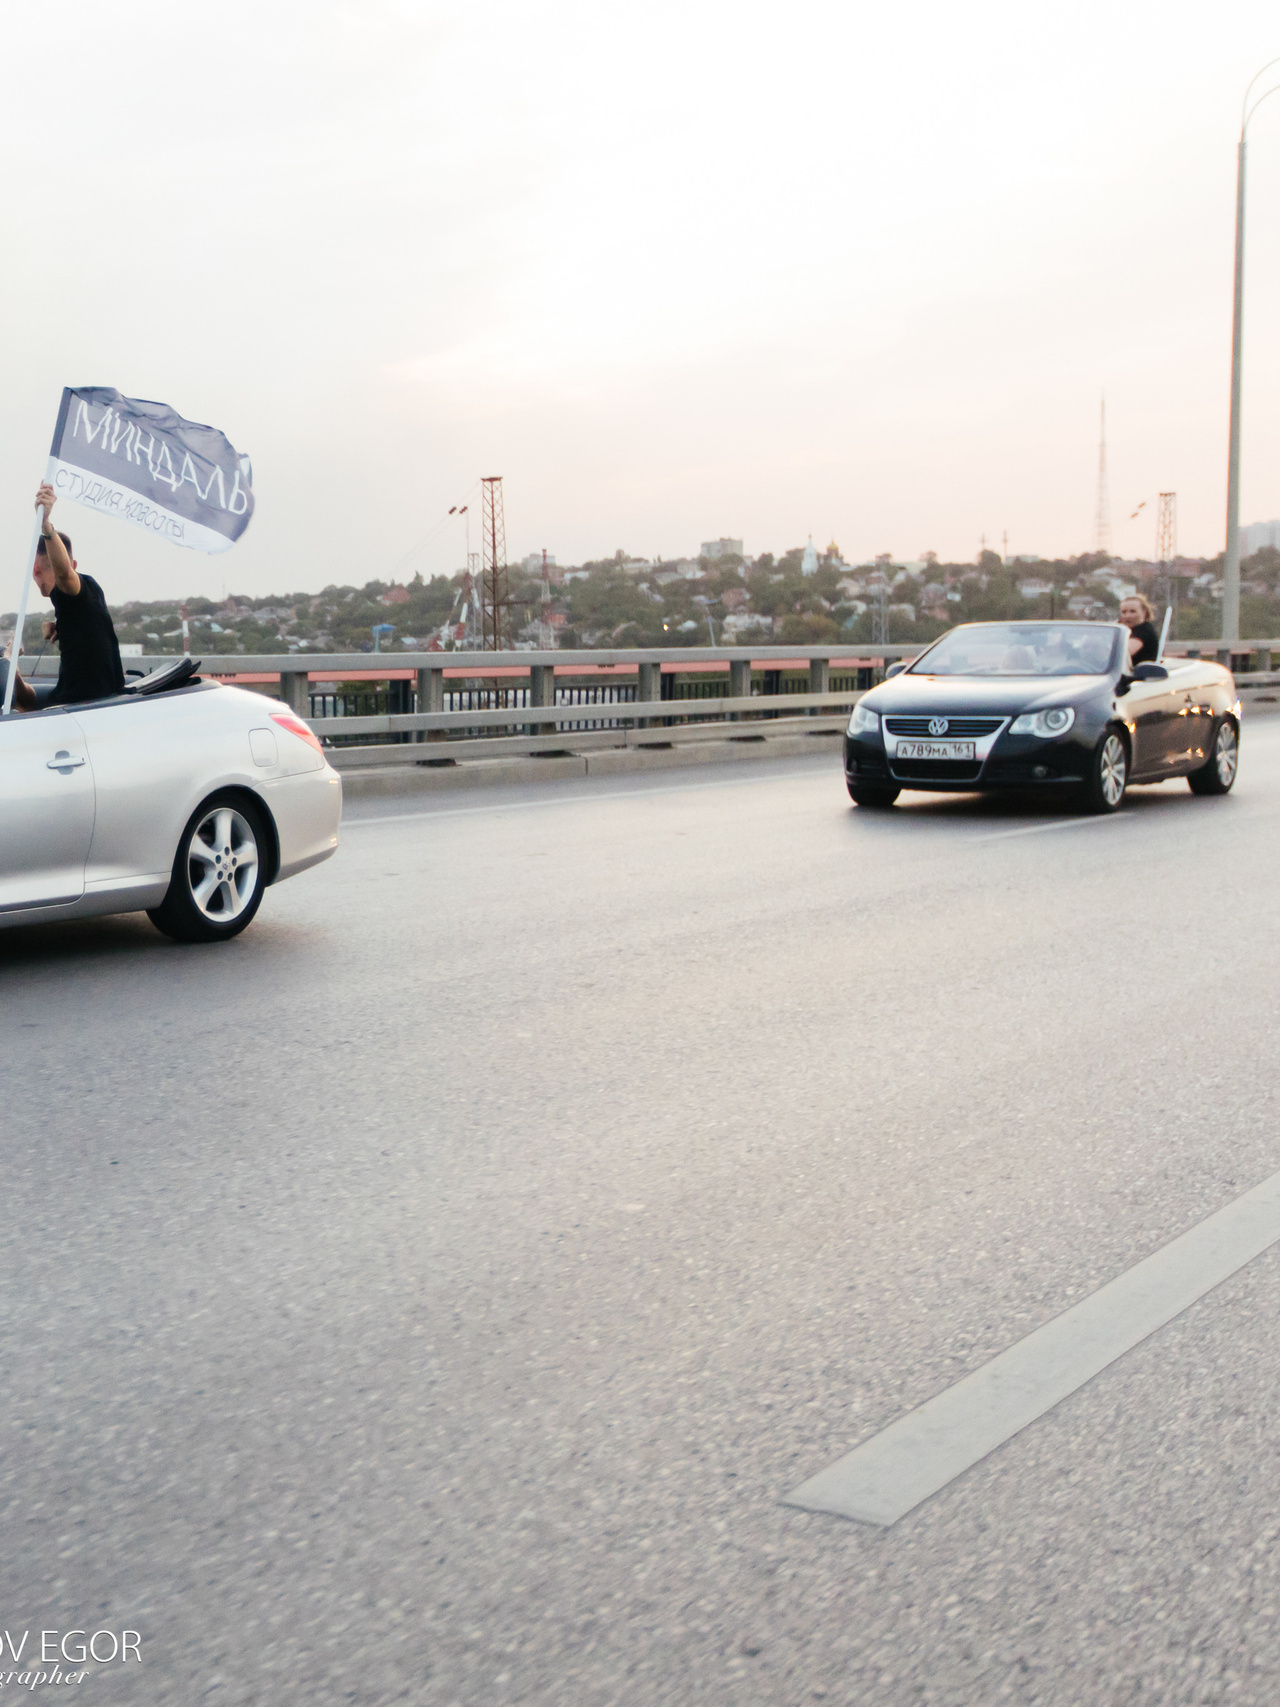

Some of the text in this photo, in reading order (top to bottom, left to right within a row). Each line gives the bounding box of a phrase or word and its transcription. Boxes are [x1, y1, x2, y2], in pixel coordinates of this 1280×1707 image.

[73, 400, 248, 515] МИНДАЛЬ
[55, 469, 123, 509] СТУДИЯ
[953, 744, 970, 754] 161
